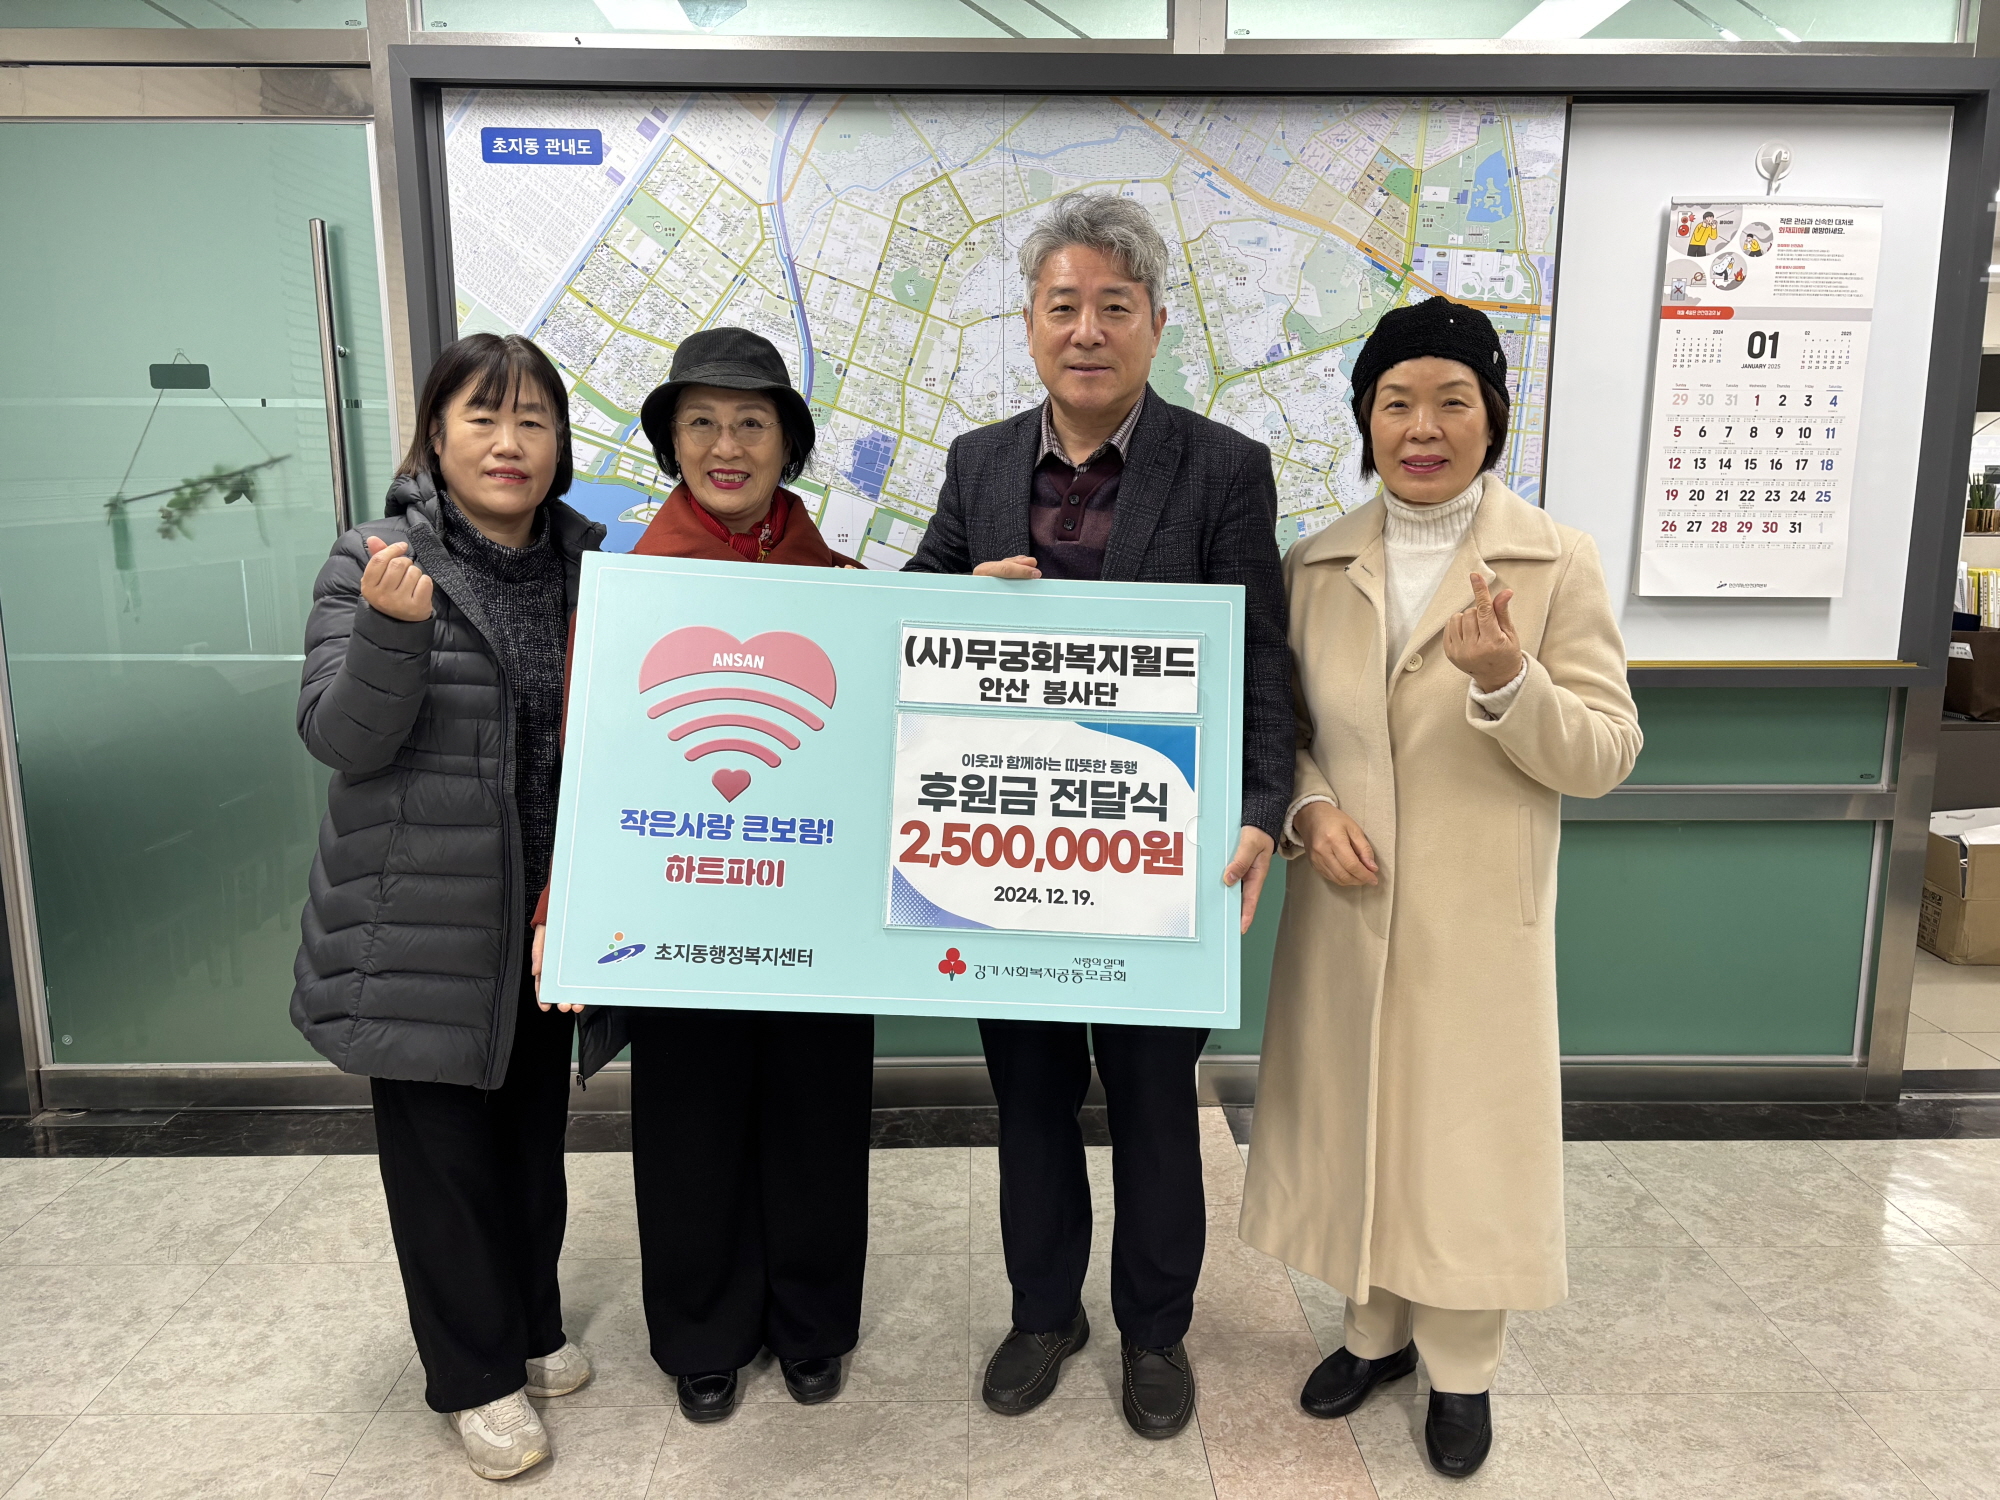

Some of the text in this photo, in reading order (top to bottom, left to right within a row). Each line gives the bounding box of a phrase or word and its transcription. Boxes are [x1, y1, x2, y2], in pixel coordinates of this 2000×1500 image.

[492, 137, 593, 155] 초지동 관내도
[1747, 331, 1779, 359] 01
[1672, 394, 1838, 407] 29 30 31 1 2 3 4
[1673, 426, 1836, 439] 5 6 7 8 9 10 11
[1668, 457, 1834, 471] 12 13 14 15 16 17 18
[1666, 489, 1831, 502] 19 20 21 22 23 24 25
[1661, 520, 1823, 533] 26 27 28 29 30 31 1
[712, 653, 765, 669] ANSAN
[904, 635, 1196, 677] (사)무궁화복지월드
[979, 677, 1119, 706] 안산 봉사단
[961, 753, 1138, 775] 이웃과 함께하는 따뜻한 동행
[918, 772, 1168, 822] 후원금 전달식
[620, 808, 834, 845] 작은사랑 큰보람!
[899, 820, 1184, 876] 2,500,000원
[665, 854, 785, 888] 하트파이
[993, 885, 1095, 906] 2024. 12. 19.
[654, 943, 813, 967] 초지동행정복지센터
